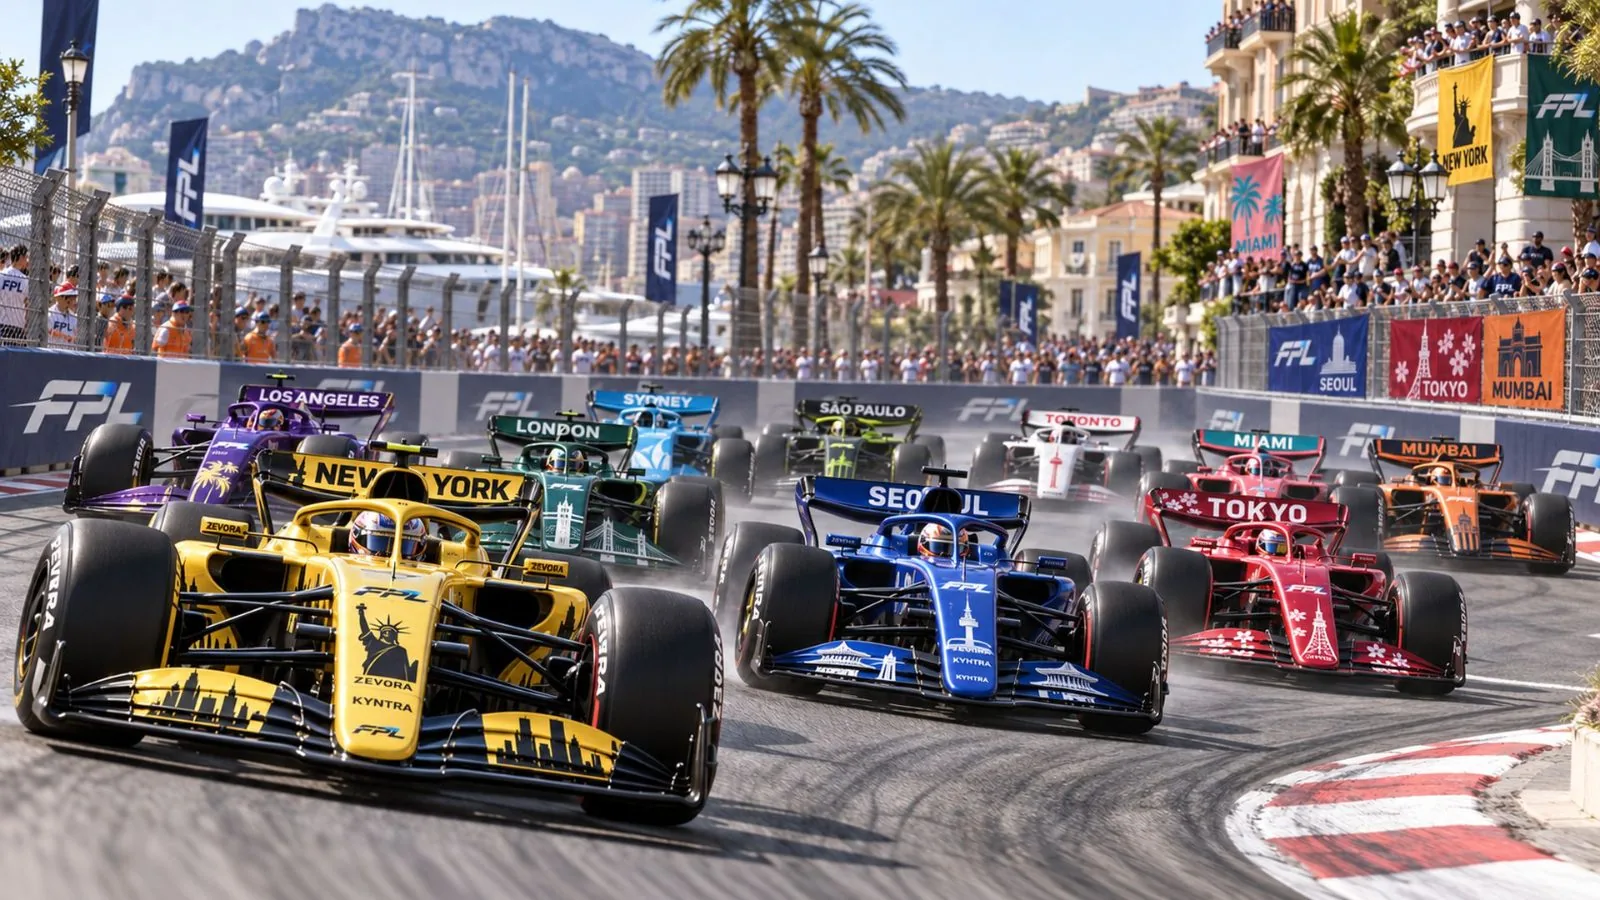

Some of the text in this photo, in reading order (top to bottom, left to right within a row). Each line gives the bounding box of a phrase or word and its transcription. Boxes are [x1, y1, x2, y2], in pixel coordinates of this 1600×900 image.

[1536, 93, 1596, 119] FPL
[1443, 145, 1488, 171] NEW YORK
[175, 148, 199, 224] FPL
[654, 217, 672, 280] FPL
[1236, 233, 1277, 253] MIAMI
[2, 280, 23, 293] FPL
[1120, 273, 1137, 323] FPL
[53, 321, 72, 332] FPL
[1274, 340, 1317, 367] FPL
[1320, 377, 1357, 392] SEOUL
[1422, 379, 1468, 398] TOKYO
[1492, 381, 1553, 401] MUMBAI
[9, 379, 143, 434] FPL
[259, 388, 380, 408] LOS ANGELES
[623, 393, 693, 408] SYDNEY
[819, 401, 906, 418] SÃO PAULO
[516, 420, 600, 439] LONDON
[1046, 414, 1122, 428] TORONTO
[1234, 434, 1293, 450] MIAMI
[1401, 441, 1478, 458] MUMBAI
[433, 474, 513, 500] YORK
[547, 482, 585, 492] FPL
[1208, 496, 1308, 523] TOKYO
[206, 522, 243, 534] ZEVORA
[531, 562, 564, 574] ZEVORA
[353, 586, 429, 603] FPL
[941, 581, 991, 594] FPL
[1284, 584, 1328, 595] FPL
[354, 676, 413, 692] ZEVORA
[352, 695, 413, 712] KYNTRA
[352, 724, 405, 739] FPL
